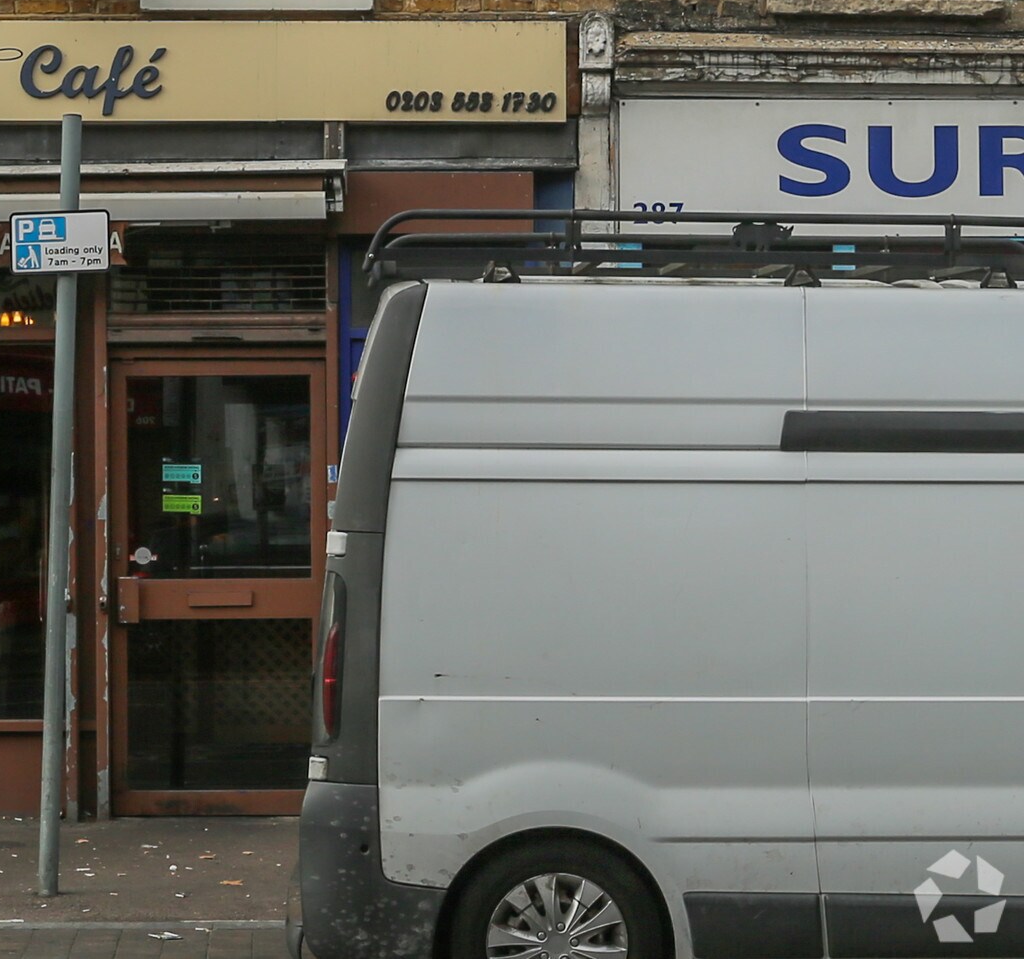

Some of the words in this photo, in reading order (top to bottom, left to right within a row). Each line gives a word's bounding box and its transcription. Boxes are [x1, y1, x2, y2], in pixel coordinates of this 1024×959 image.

[19, 44, 167, 116] Café
[501, 91, 556, 113] 1730
[18, 220, 34, 241] P
[44, 246, 80, 256] loading
[83, 245, 104, 255] only
[48, 257, 69, 266] 7am
[80, 257, 102, 267] 7pm
